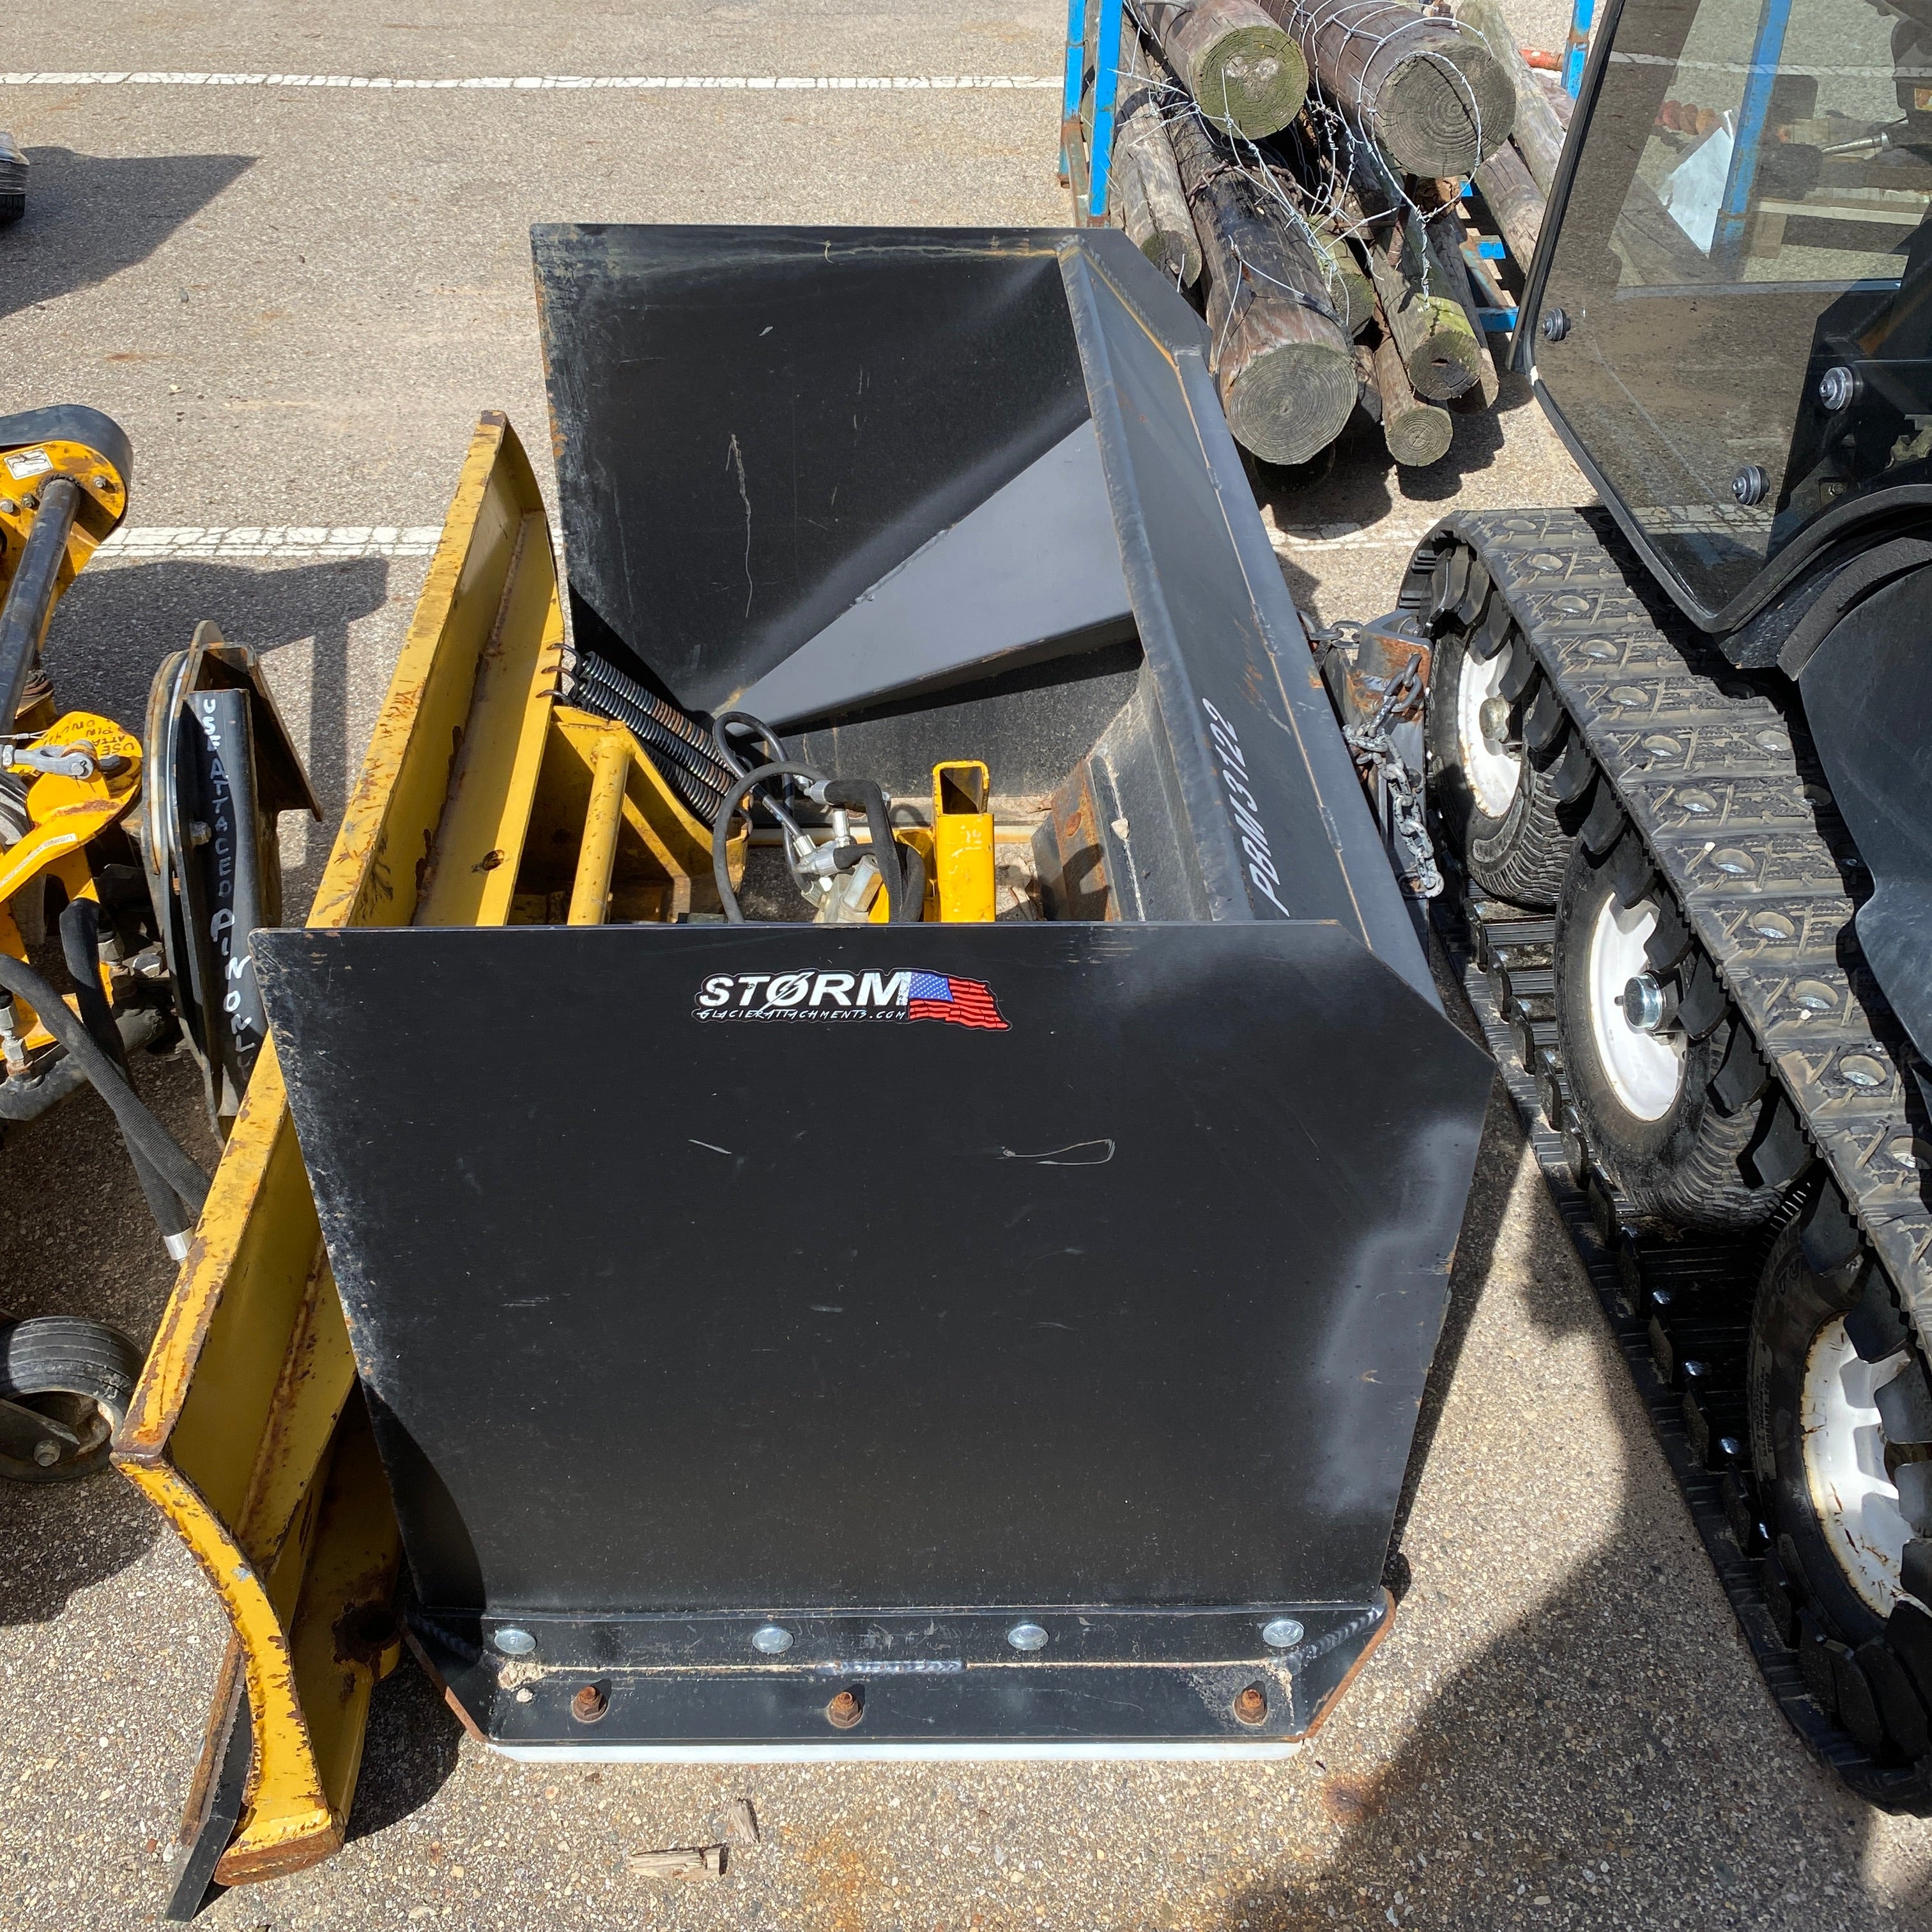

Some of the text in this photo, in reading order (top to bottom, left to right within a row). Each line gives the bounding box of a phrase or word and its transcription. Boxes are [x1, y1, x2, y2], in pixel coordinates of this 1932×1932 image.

[100, 742, 135, 756] USE
[203, 699, 221, 751] USE
[1202, 698, 1291, 917] PBM3122
[210, 908, 252, 980] PIN
